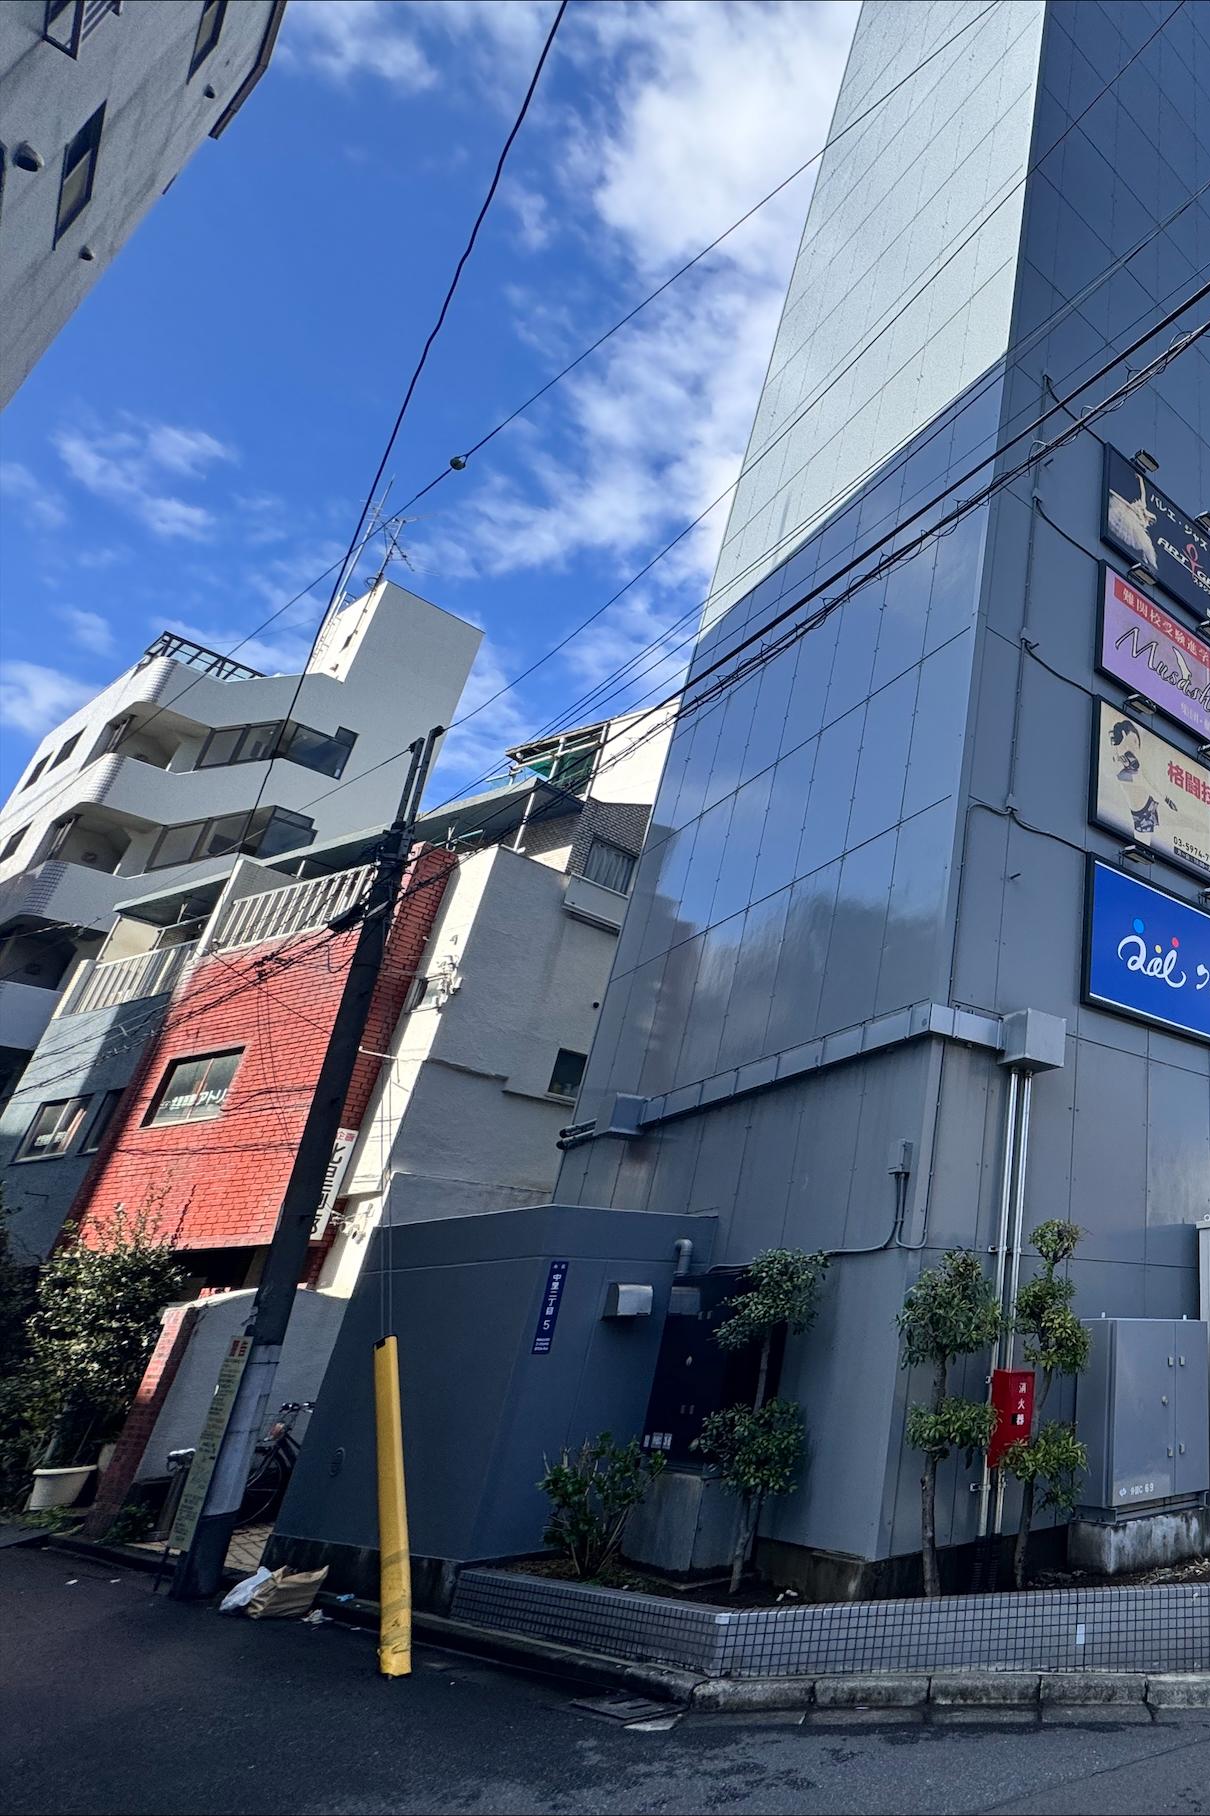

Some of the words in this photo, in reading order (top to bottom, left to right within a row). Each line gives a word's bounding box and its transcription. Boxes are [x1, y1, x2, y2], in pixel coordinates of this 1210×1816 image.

[1157, 537, 1189, 566] ART
[545, 1274, 562, 1315] 中里二丁目
[542, 1320, 551, 1330] 5
[1015, 1382, 1028, 1426] 消火器
[1144, 1483, 1154, 1493] 69
